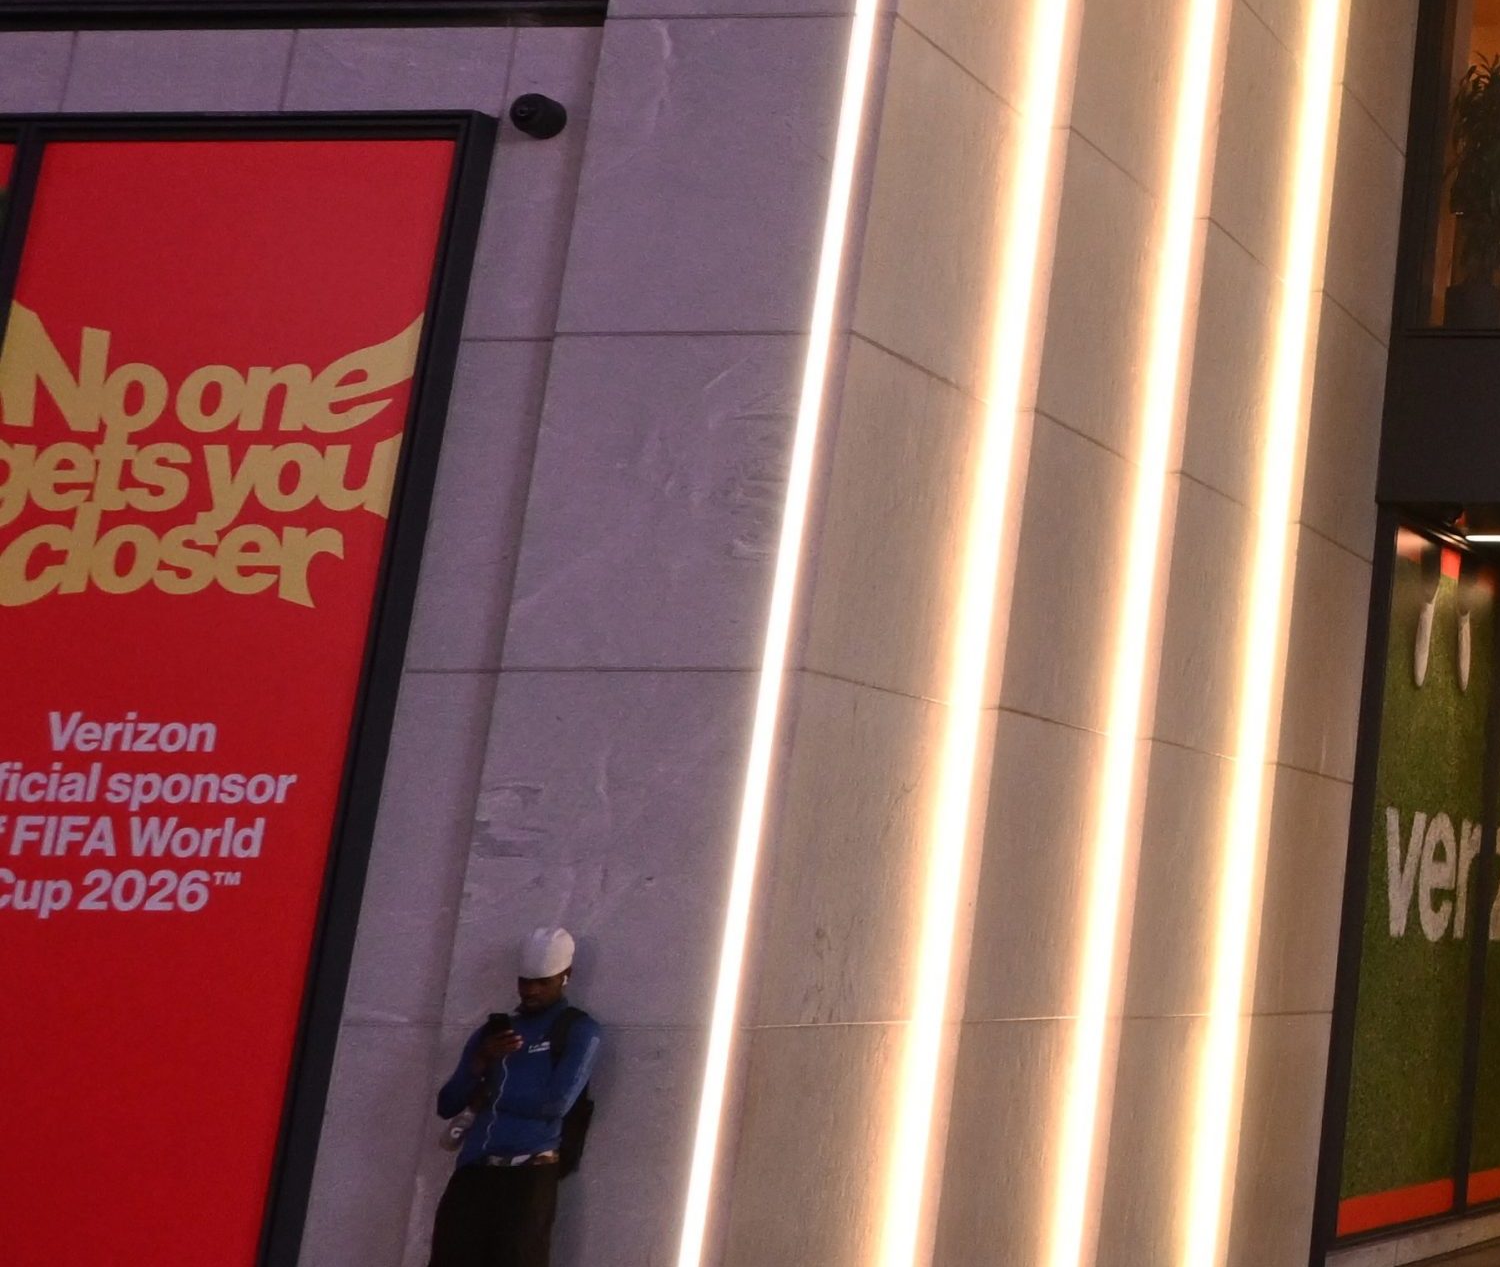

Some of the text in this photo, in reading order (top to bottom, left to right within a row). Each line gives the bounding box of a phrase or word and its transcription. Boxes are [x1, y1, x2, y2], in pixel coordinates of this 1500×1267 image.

[0, 299, 424, 433] No one
[195, 432, 403, 536] you
[0, 501, 345, 609] closer
[48, 711, 217, 753] Verizon
[104, 773, 298, 811] sponsor
[9, 815, 117, 857] FIFA
[129, 815, 266, 858] World
